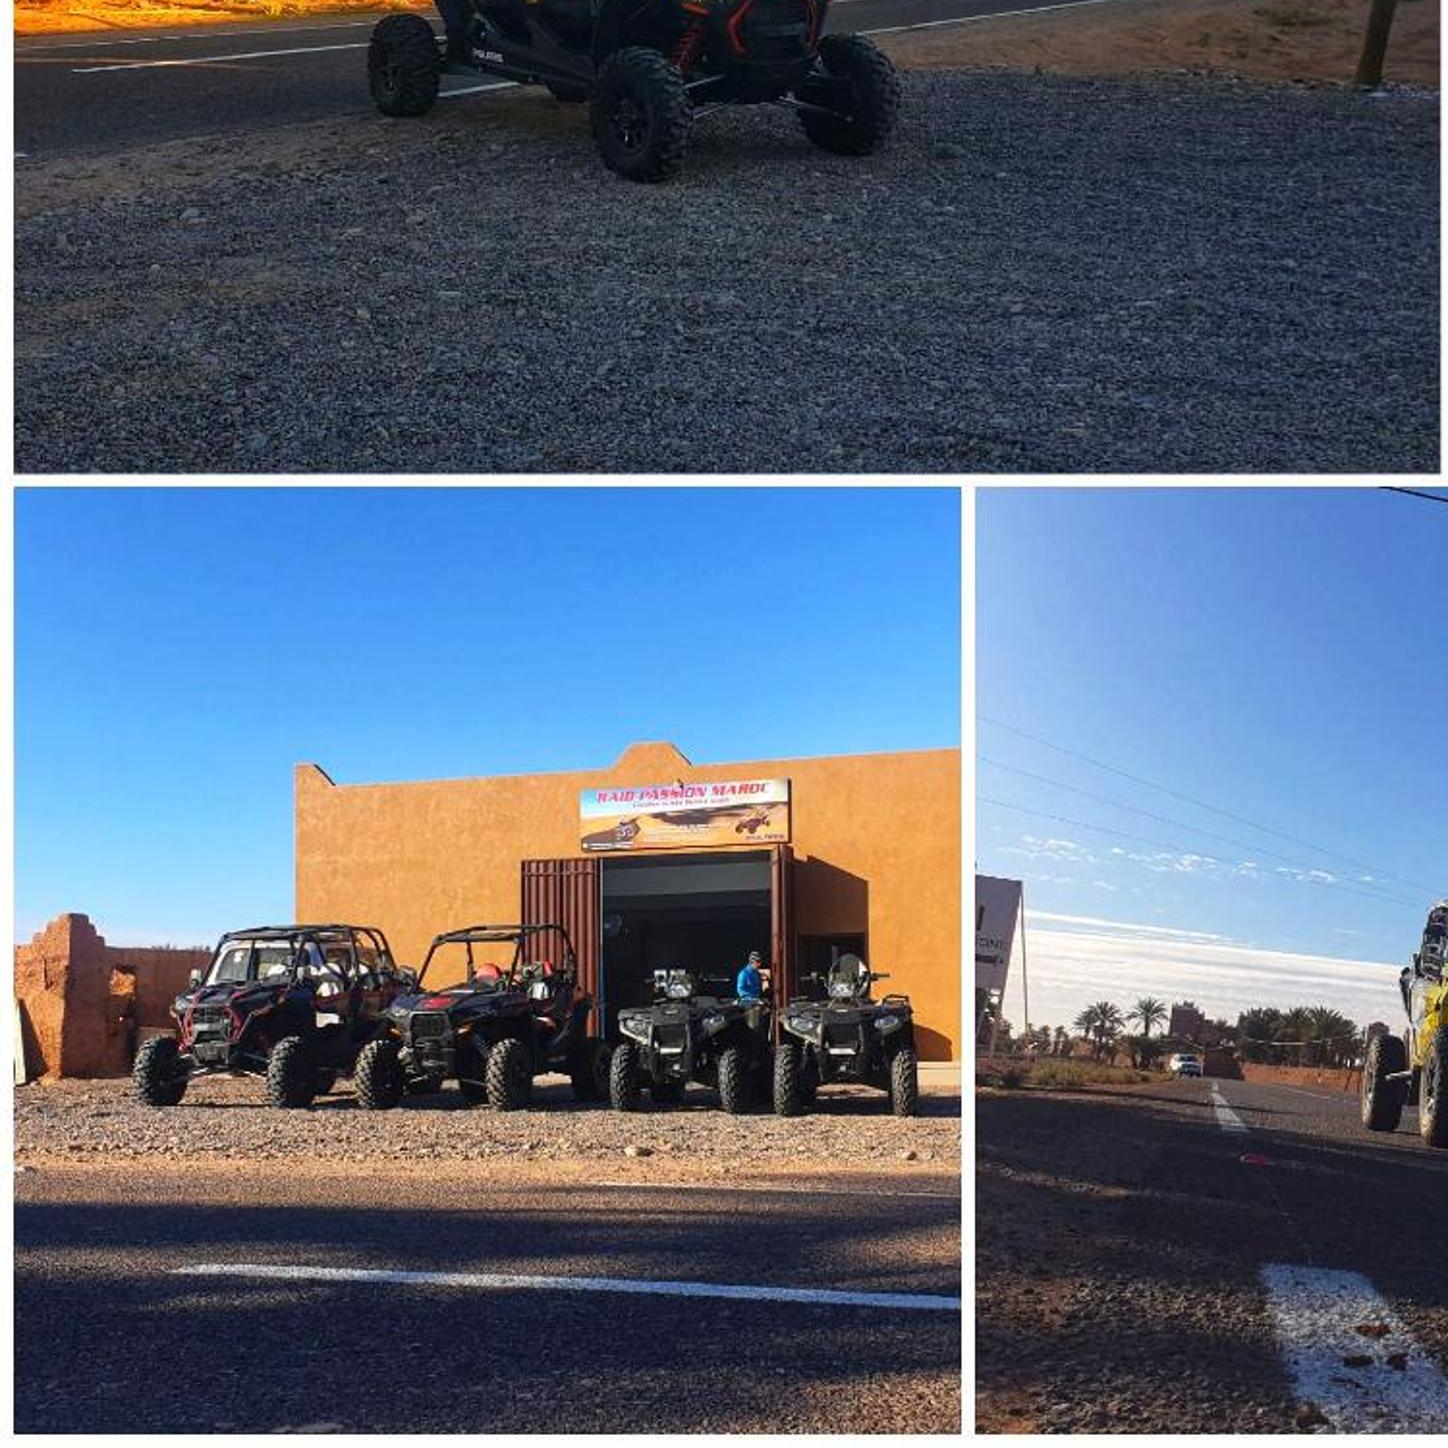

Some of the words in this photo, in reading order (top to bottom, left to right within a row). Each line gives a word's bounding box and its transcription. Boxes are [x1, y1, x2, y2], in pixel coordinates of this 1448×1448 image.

[597, 790, 634, 803] RAID
[639, 786, 707, 800] PASSION
[712, 783, 768, 796] MAROC
